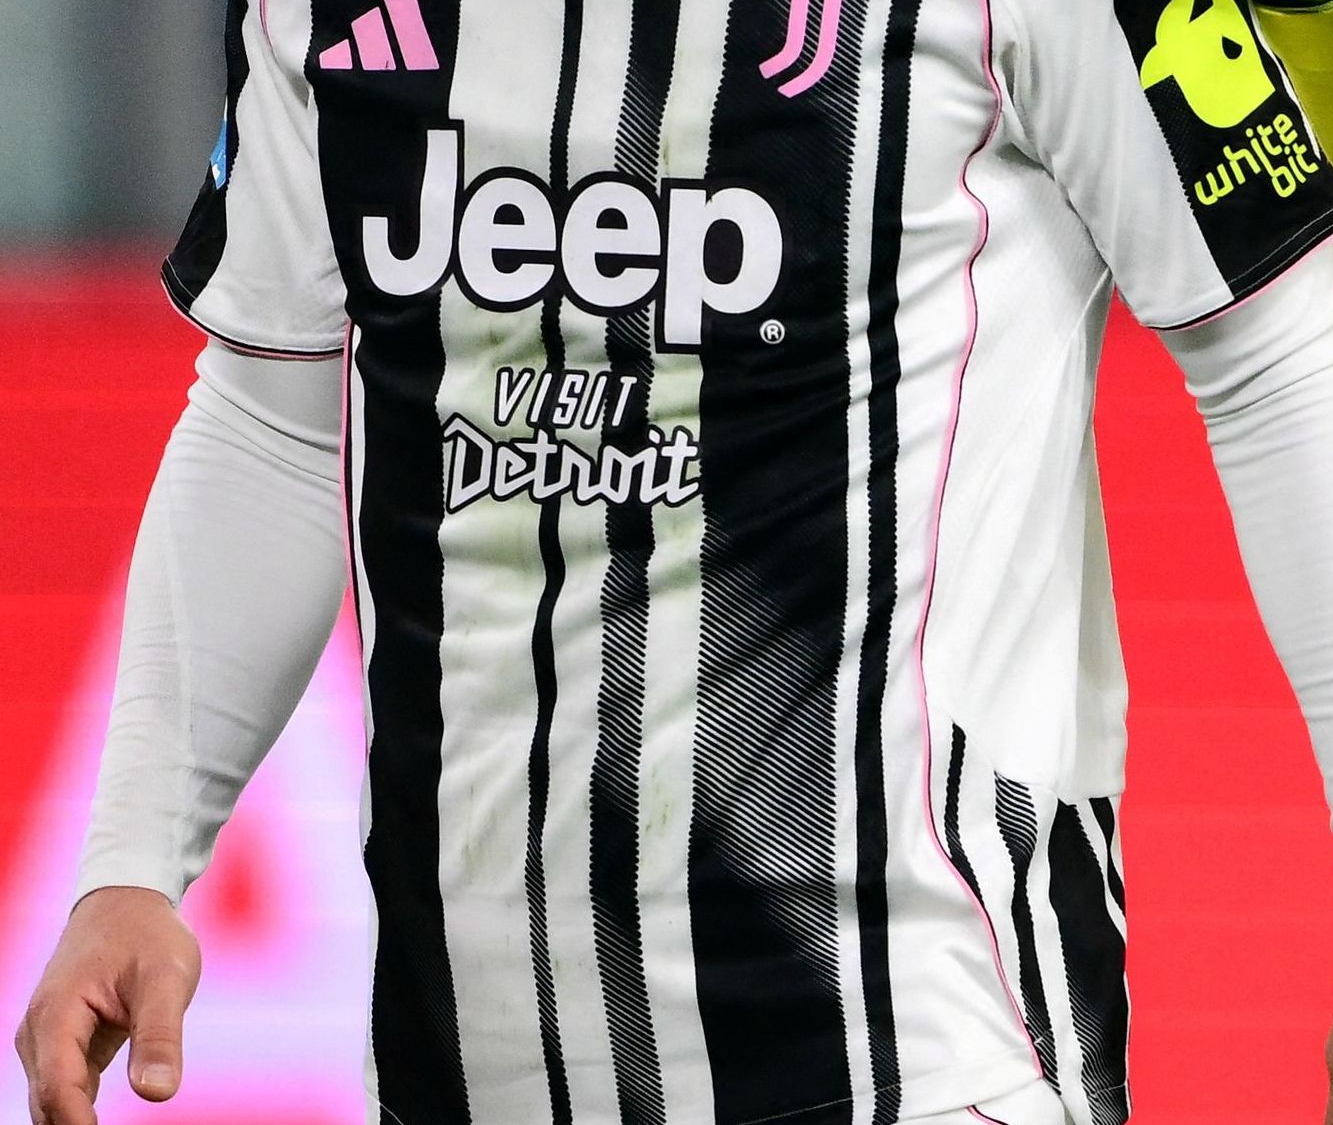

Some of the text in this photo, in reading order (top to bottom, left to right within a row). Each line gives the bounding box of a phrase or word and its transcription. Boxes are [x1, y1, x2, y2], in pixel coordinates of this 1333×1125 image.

[1194, 113, 1299, 206] white
[1260, 142, 1320, 198] bit
[359, 125, 786, 343] Jeep
[494, 369, 639, 429] VISIT
[444, 420, 703, 510] Detroit
